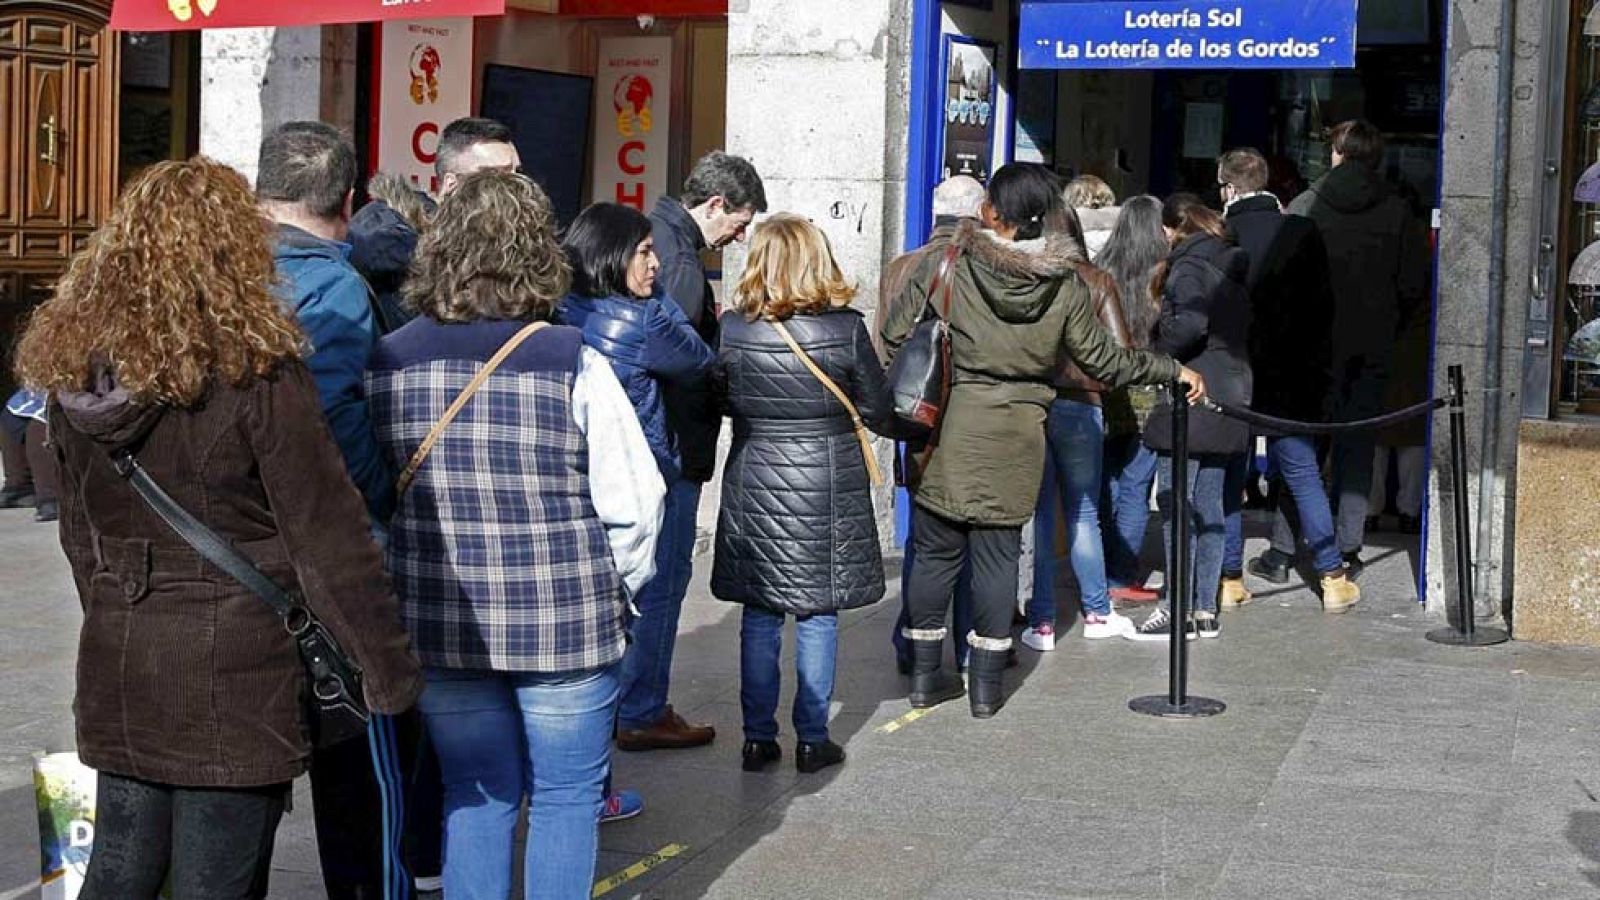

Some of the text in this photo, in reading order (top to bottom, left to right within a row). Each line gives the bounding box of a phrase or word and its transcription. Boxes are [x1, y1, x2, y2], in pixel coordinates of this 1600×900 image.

[1124, 8, 1242, 28] Lotería Sol
[1055, 40, 1080, 58] La
[1085, 38, 1160, 58] Lotería
[1166, 38, 1193, 58] de
[1199, 38, 1232, 58] los
